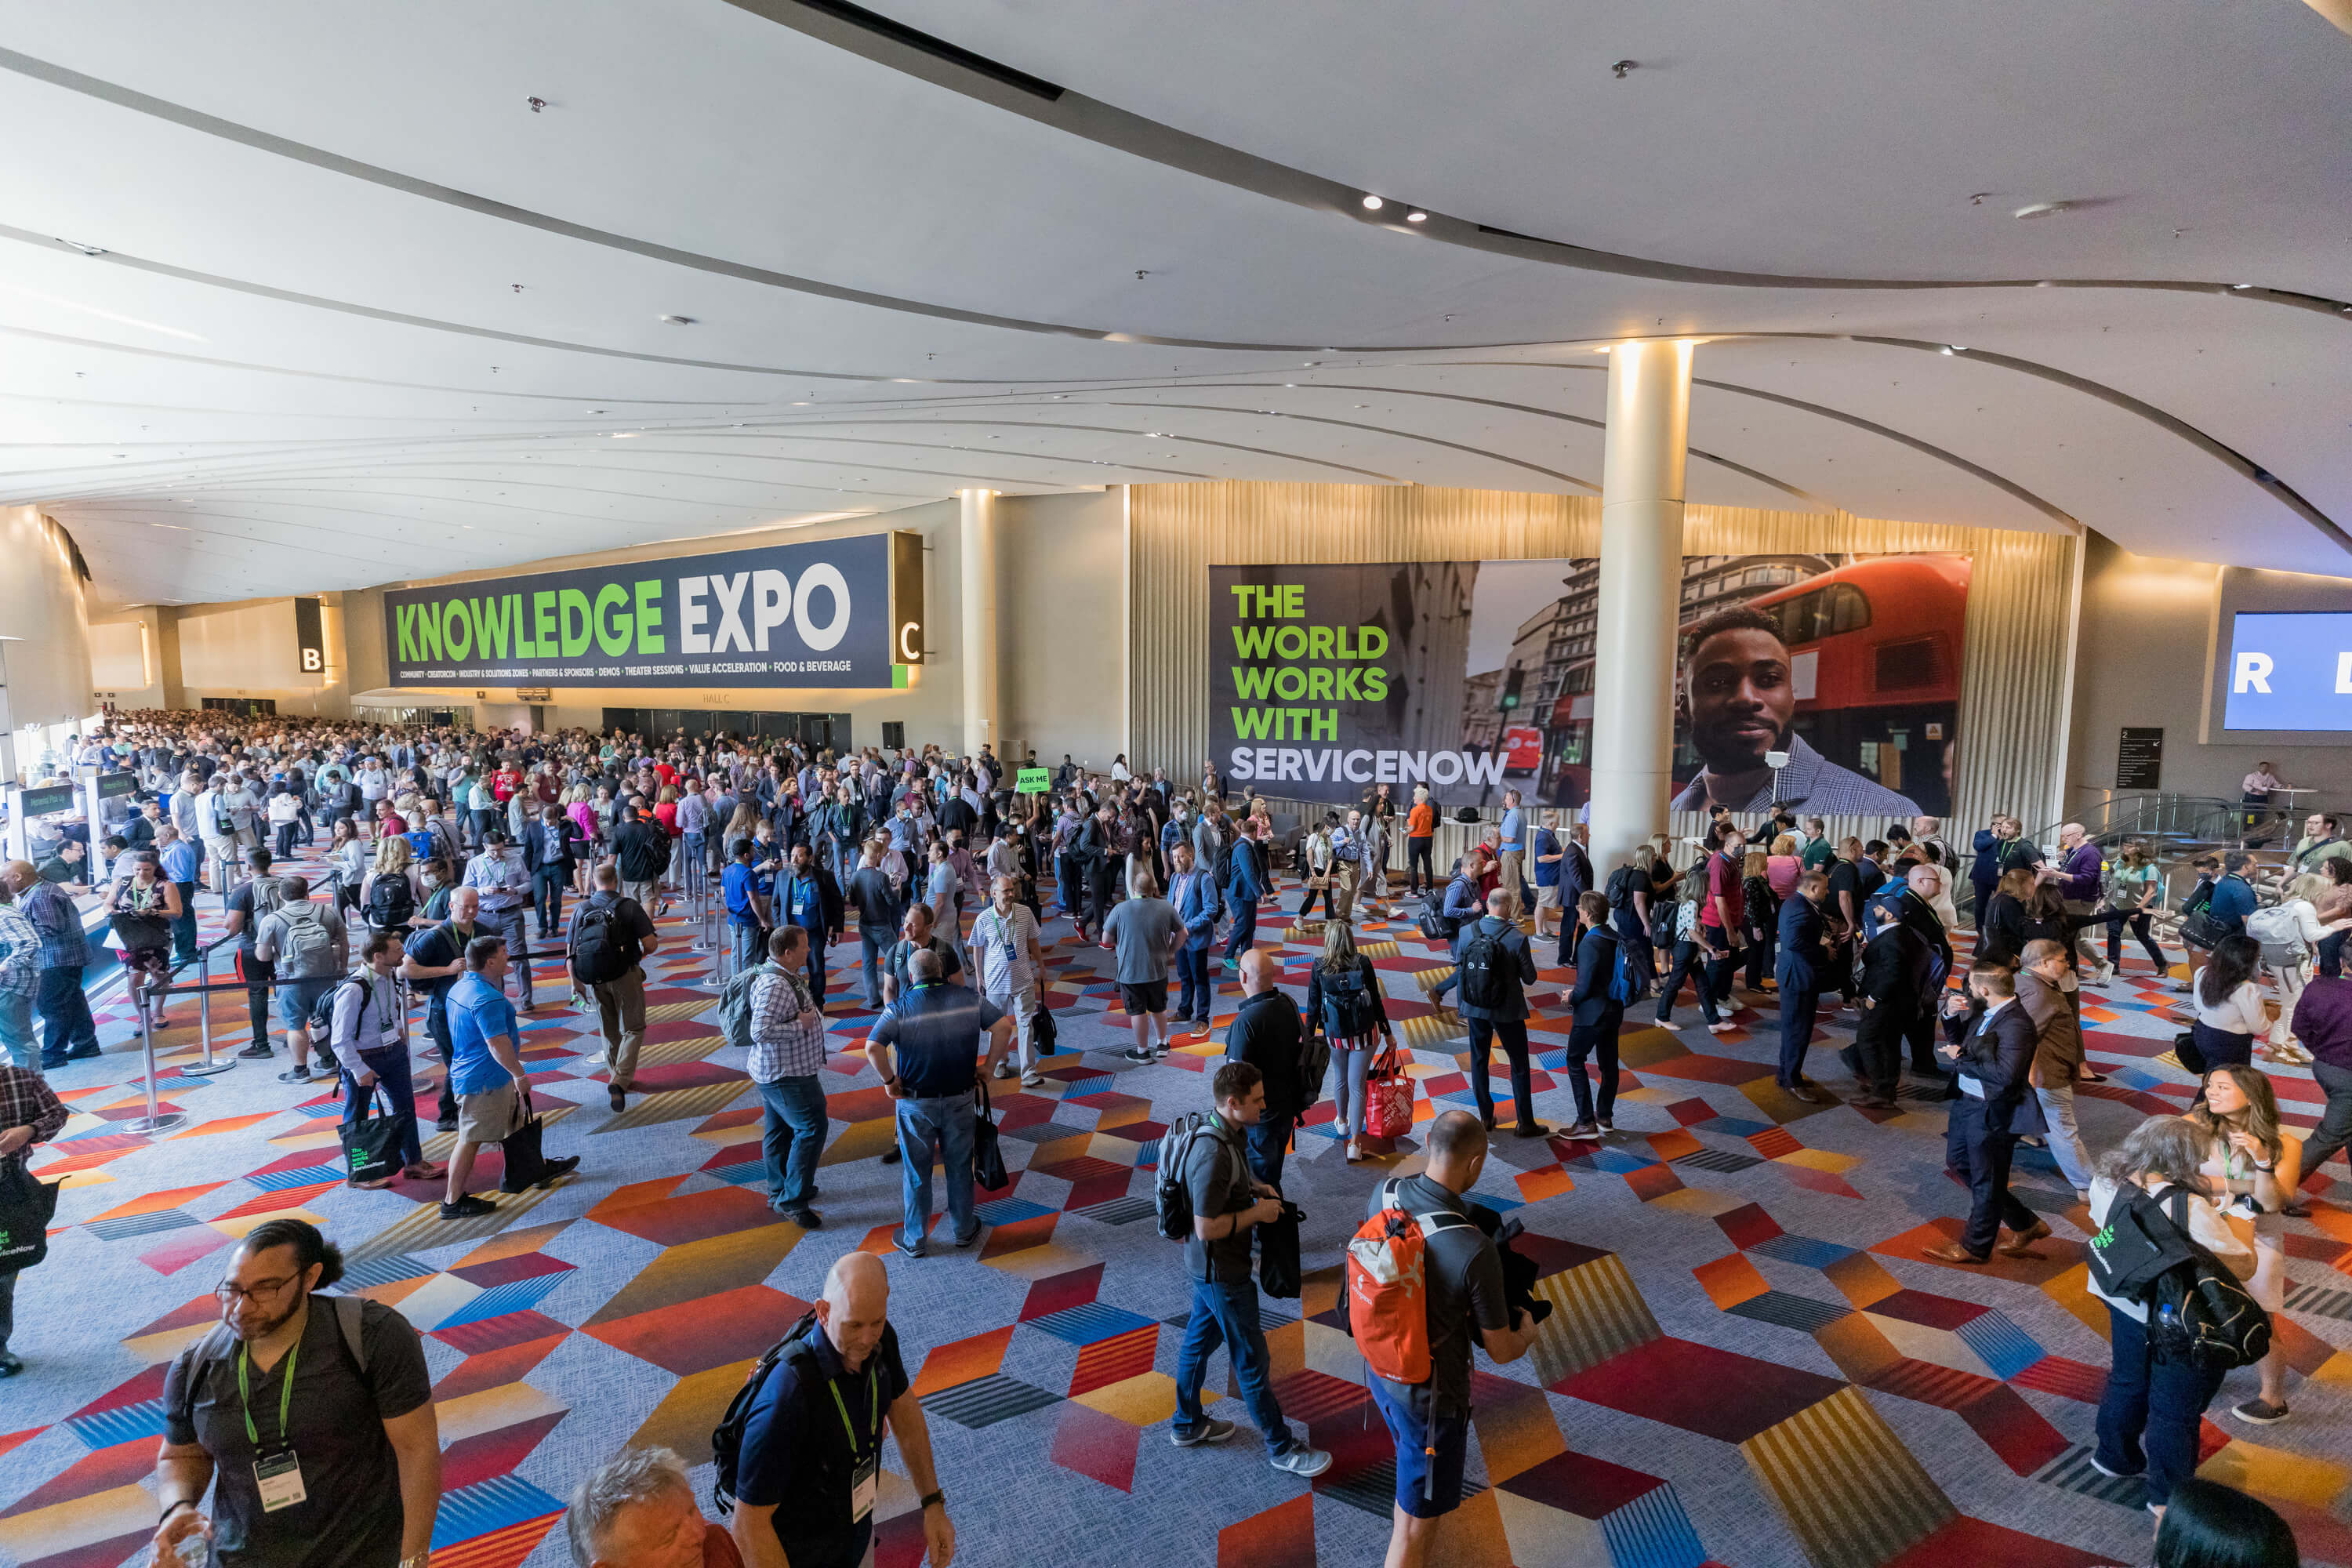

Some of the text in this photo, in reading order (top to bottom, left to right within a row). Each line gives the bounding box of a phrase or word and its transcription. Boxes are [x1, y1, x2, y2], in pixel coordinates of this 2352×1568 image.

[396, 562, 851, 662] KNOWLEDGE EXPO
[1231, 584, 1305, 618] THE
[901, 622, 920, 659] C
[1232, 626, 1388, 659] WORLD
[303, 648, 321, 670] B
[459, 670, 481, 678] INDUSTRY
[512, 669, 528, 677] ZONES
[532, 668, 558, 677] PARTNERS
[564, 667, 594, 677] SPONSORS
[598, 666, 620, 677] DEMOS
[625, 666, 652, 676] THEATER
[652, 665, 684, 675] SESSIONS
[689, 664, 710, 674] VALUE
[712, 662, 767, 673] ACCELERATION
[773, 662, 797, 673] FOOD
[799, 662, 805, 672] &
[806, 660, 851, 672] BEVERAGE
[2234, 652, 2274, 693] R
[703, 694, 723, 703] HALL
[1232, 666, 1388, 702] WORKS
[1231, 707, 1338, 741] WITH
[1230, 746, 1509, 786] SERVICENOW
